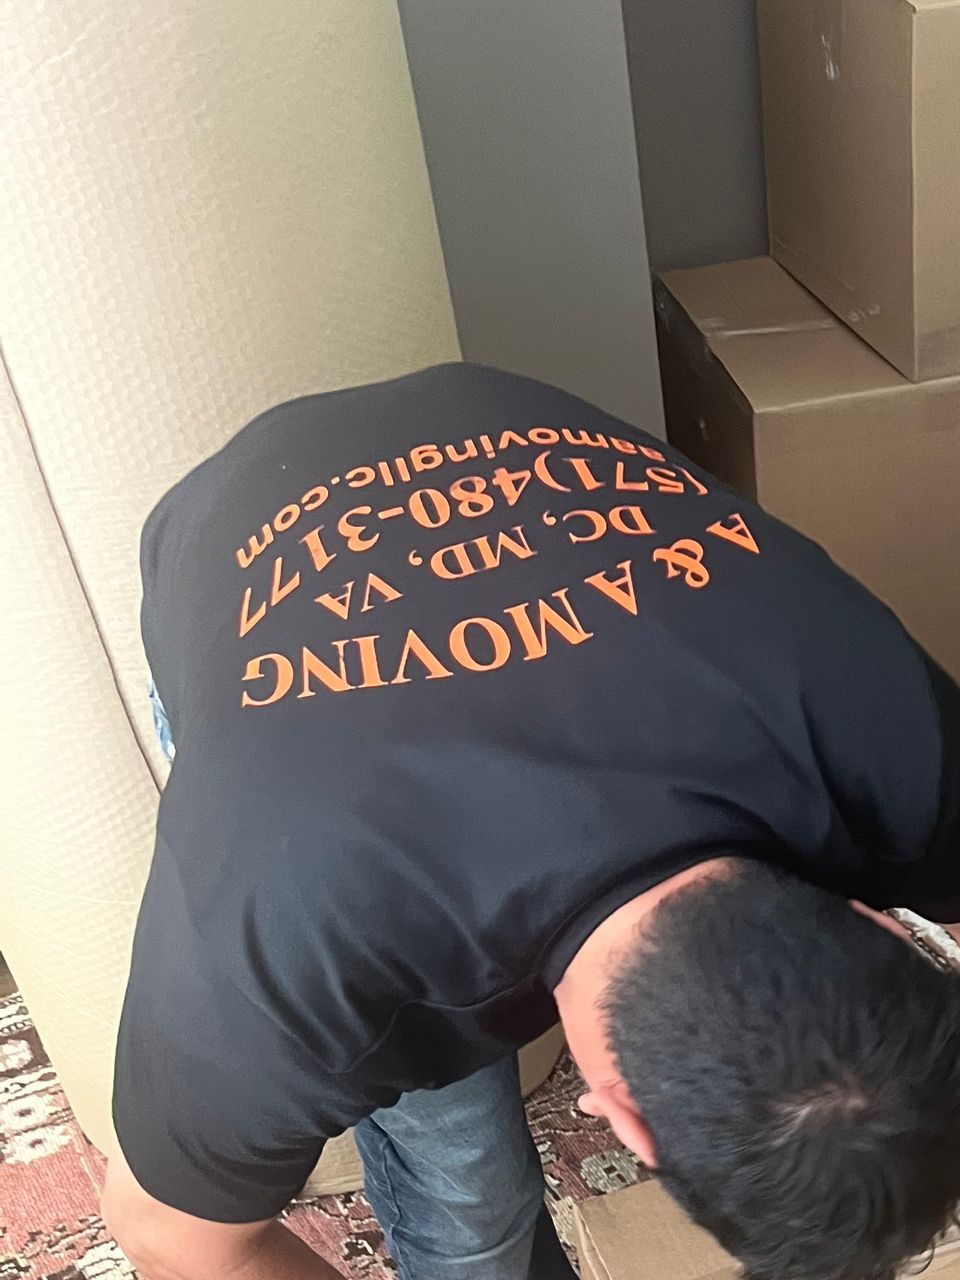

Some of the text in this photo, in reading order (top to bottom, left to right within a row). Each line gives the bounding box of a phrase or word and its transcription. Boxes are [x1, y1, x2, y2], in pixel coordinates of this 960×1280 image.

[235, 427, 665, 568] aamovingllc.com
[237, 450, 708, 637] (571)480-3177
[316, 506, 653, 620] DC, MD, VA
[242, 515, 760, 707] A & A MOVING
